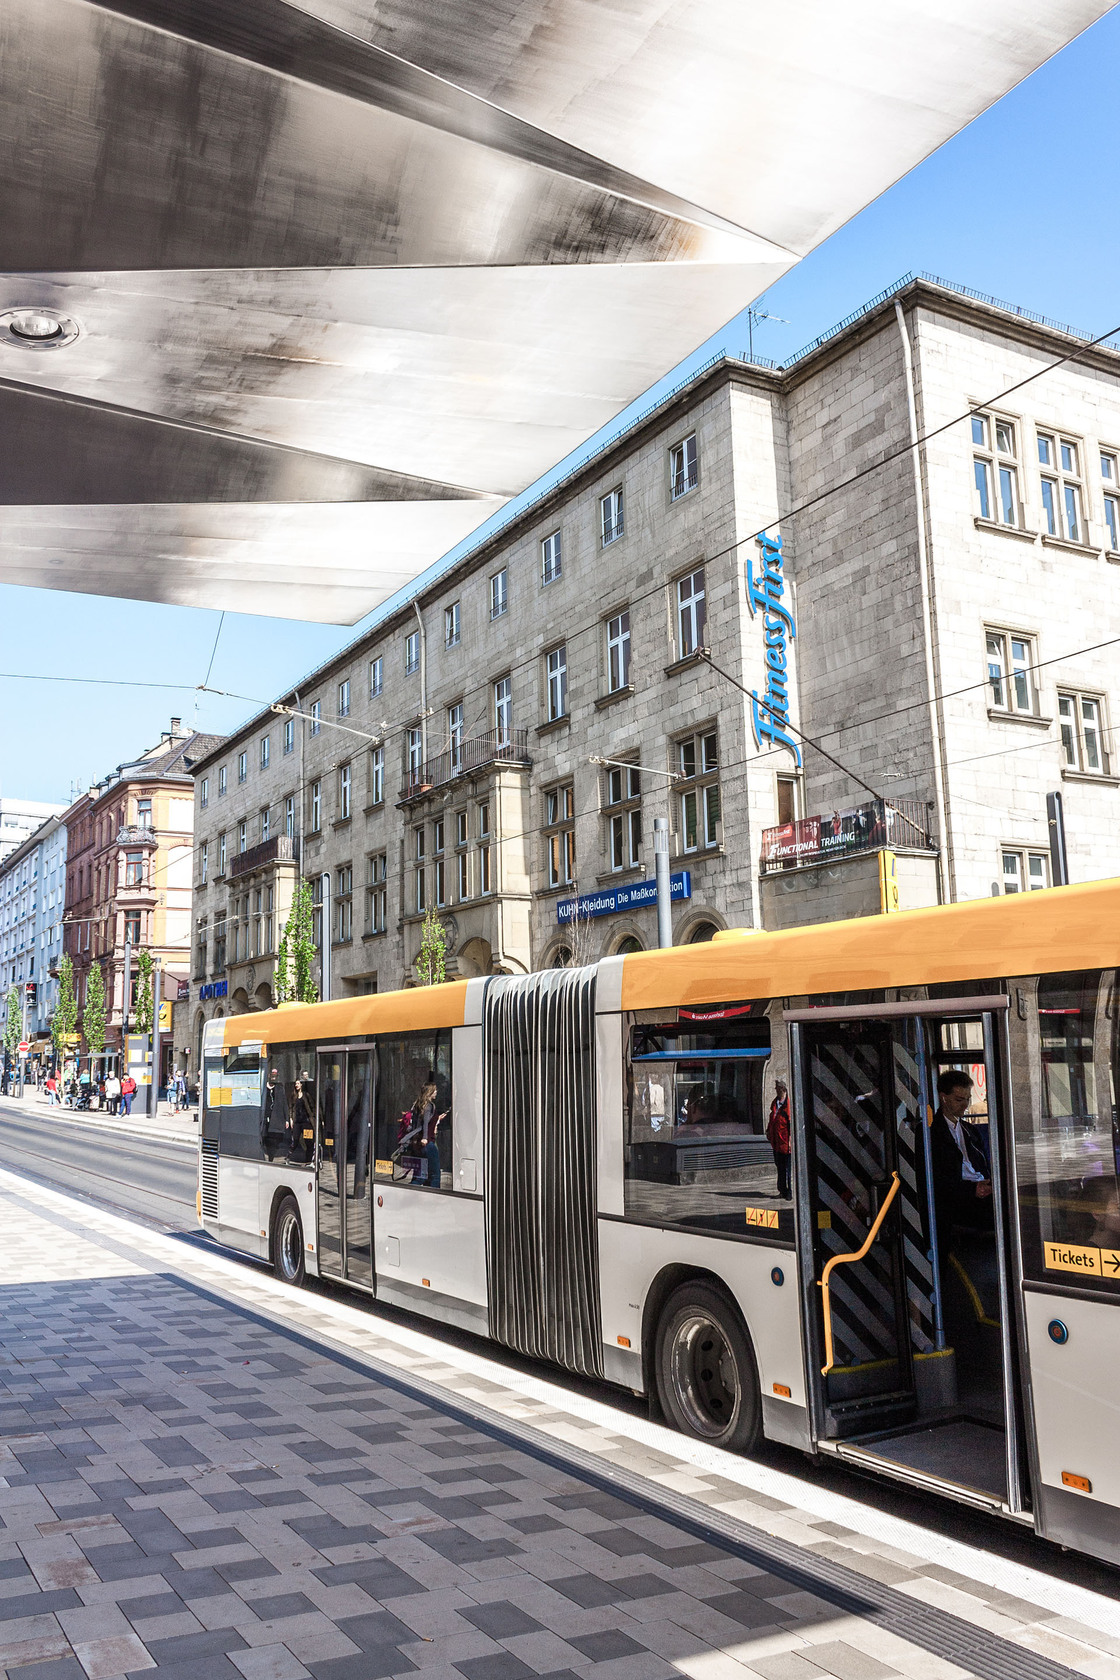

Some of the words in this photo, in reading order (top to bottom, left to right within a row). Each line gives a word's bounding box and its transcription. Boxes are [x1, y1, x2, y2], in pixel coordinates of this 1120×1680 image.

[820, 831, 855, 848] TRAINING
[558, 895, 615, 918] KUHN-Kleidung
[617, 893, 629, 904] Die
[630, 881, 683, 900] Maßkonion
[1050, 1248, 1095, 1268] Tickets
